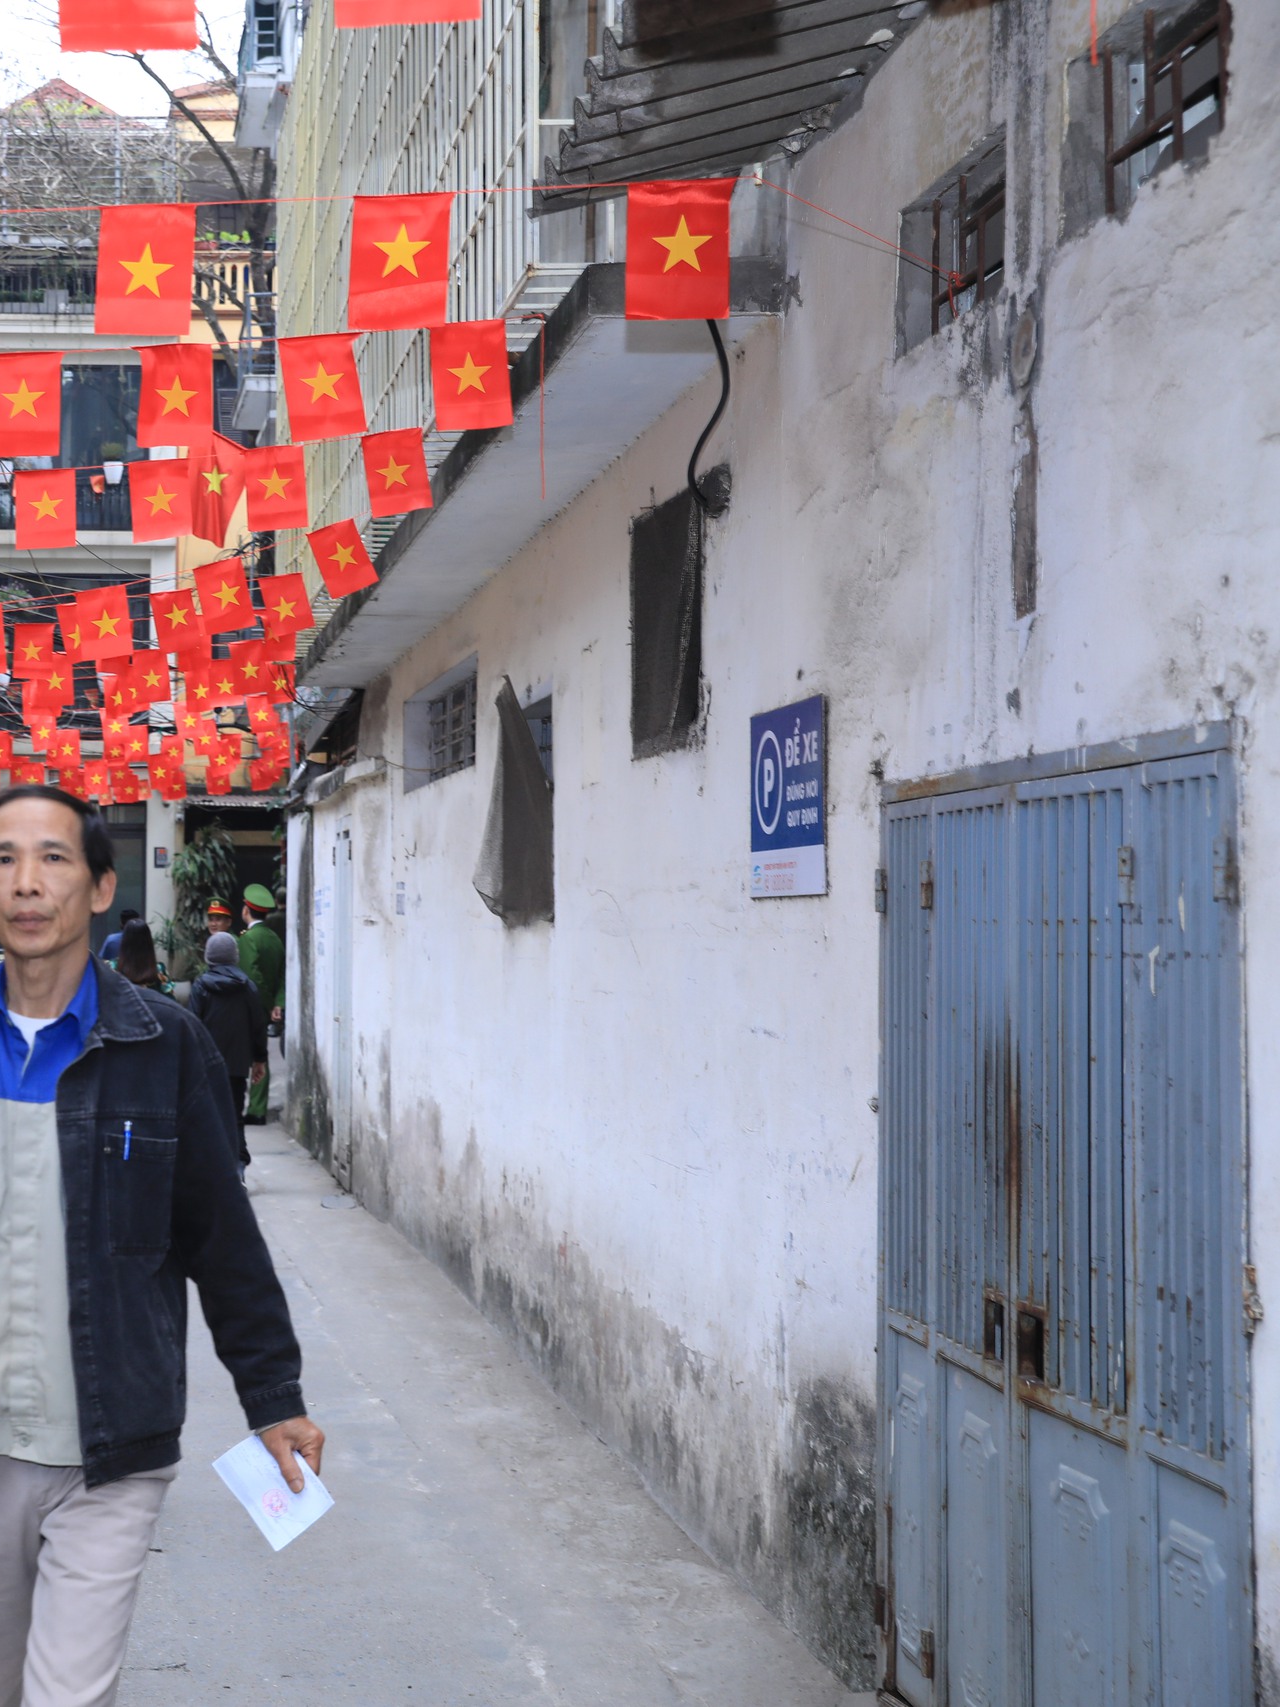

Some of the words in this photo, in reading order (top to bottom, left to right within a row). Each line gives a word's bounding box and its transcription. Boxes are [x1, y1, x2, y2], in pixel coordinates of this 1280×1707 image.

[785, 717, 801, 768] ĐỂ
[802, 730, 818, 764] XE
[763, 758, 775, 808] P
[786, 780, 805, 802] ĐÚNG
[805, 778, 818, 798] NƠI
[787, 810, 801, 827] QUY
[801, 807, 818, 830] ĐỊNH
